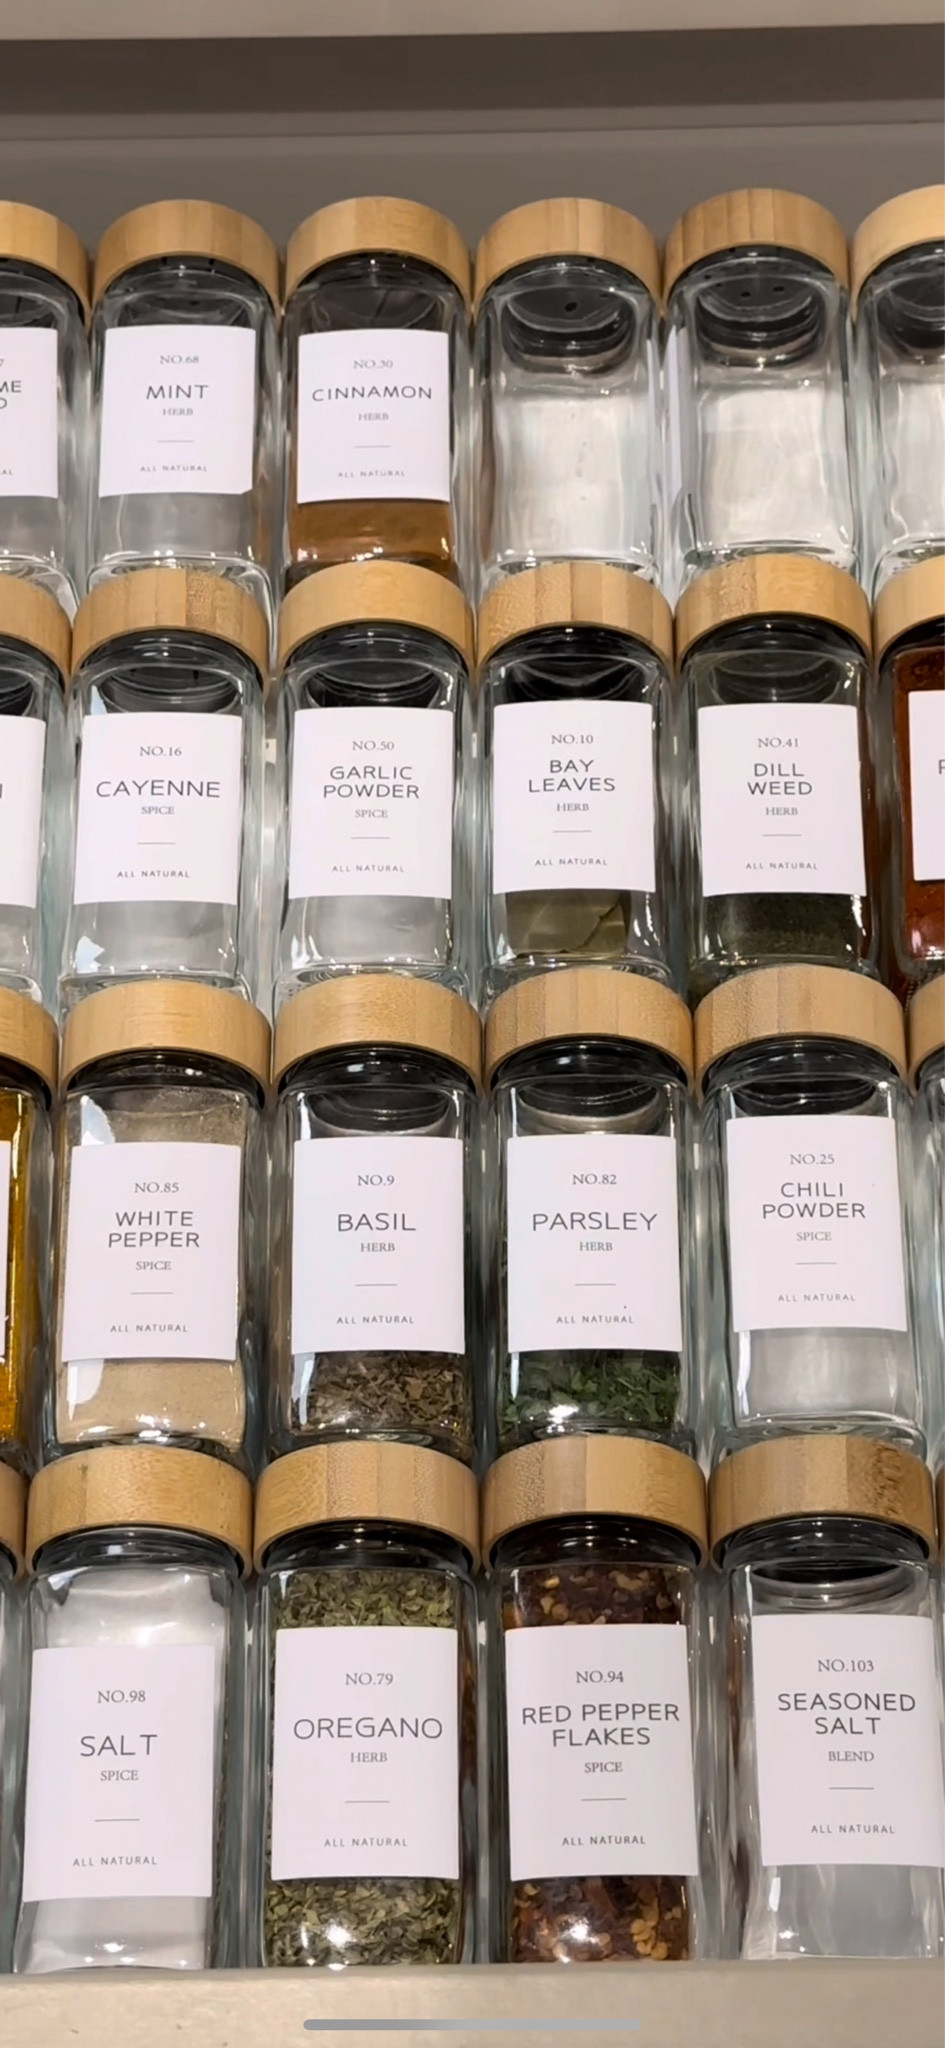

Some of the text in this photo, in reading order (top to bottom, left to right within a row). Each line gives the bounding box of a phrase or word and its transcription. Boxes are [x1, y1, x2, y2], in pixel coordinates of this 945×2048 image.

[159, 354, 200, 365] NO.68
[353, 359, 394, 370] NO.30
[145, 384, 209, 400] MINT
[311, 385, 432, 402] CINNAMON
[162, 407, 194, 417] HERB
[358, 412, 390, 422] HERB
[139, 464, 207, 473] ALL NATURAL
[337, 469, 405, 479] ALL NATURAL
[352, 740, 395, 751] NO.50
[551, 734, 594, 745] NO.10
[757, 737, 799, 749] NO.41
[139, 745, 183, 757] NO.16
[329, 765, 413, 781] GARLIC
[549, 759, 594, 774] BAY
[753, 762, 805, 778] DILL
[95, 779, 221, 799] CAYENNE
[323, 783, 420, 799] POWDER
[528, 777, 616, 793] LEAVES
[747, 780, 813, 796] WEED
[141, 805, 175, 815] SPICE
[354, 809, 389, 819] SPICE
[556, 802, 590, 813] HERB
[765, 806, 799, 816] HERB
[331, 864, 405, 873] ALL NATURAL
[534, 857, 608, 867] ALL NATURAL
[745, 861, 818, 871] ALL NATURAL
[116, 869, 189, 879] ALL NATURAL
[789, 1153, 836, 1166] NO.25
[357, 1174, 395, 1187] NO.9
[572, 1173, 617, 1186] NO.82
[134, 1181, 180, 1194] NO.85
[780, 1181, 844, 1198] CHILI
[762, 1202, 866, 1220] POWDER
[115, 1210, 194, 1227] WHITE
[337, 1212, 417, 1232] BASIL
[532, 1211, 658, 1232] PARSLEY
[108, 1231, 200, 1248] PEPPER
[796, 1231, 832, 1242] SPICE
[360, 1242, 396, 1253] HERB
[579, 1241, 614, 1252] HERB
[135, 1260, 172, 1271] SPICE
[777, 1292, 855, 1303] ALL NATURAL
[336, 1314, 414, 1325] ALL NATURAL
[555, 1314, 634, 1325] ALL NATURAL
[109, 1323, 187, 1333] ALL NATURAL
[817, 1658, 875, 1673] NO.103
[345, 1672, 394, 1686] NO.79
[575, 1670, 624, 1684] NO.94
[97, 1689, 146, 1704] NO.98
[777, 1692, 916, 1712] SEASONED
[522, 1702, 680, 1726] RED PEPPER
[293, 1716, 443, 1740] OREGANO
[814, 1716, 881, 1735] SALT
[552, 1726, 651, 1748] FLAKES
[80, 1734, 158, 1758] SALT
[350, 1751, 388, 1763] HERB
[827, 1750, 875, 1763] BLEND
[584, 1761, 624, 1774] SPICE
[99, 1769, 140, 1782] SPICE
[810, 1823, 895, 1835] ALL NATURAL
[323, 1837, 407, 1848] ALL NATURAL
[561, 1835, 646, 1846] ALL NATURAL
[72, 1855, 157, 1867] ALL NATURAL
